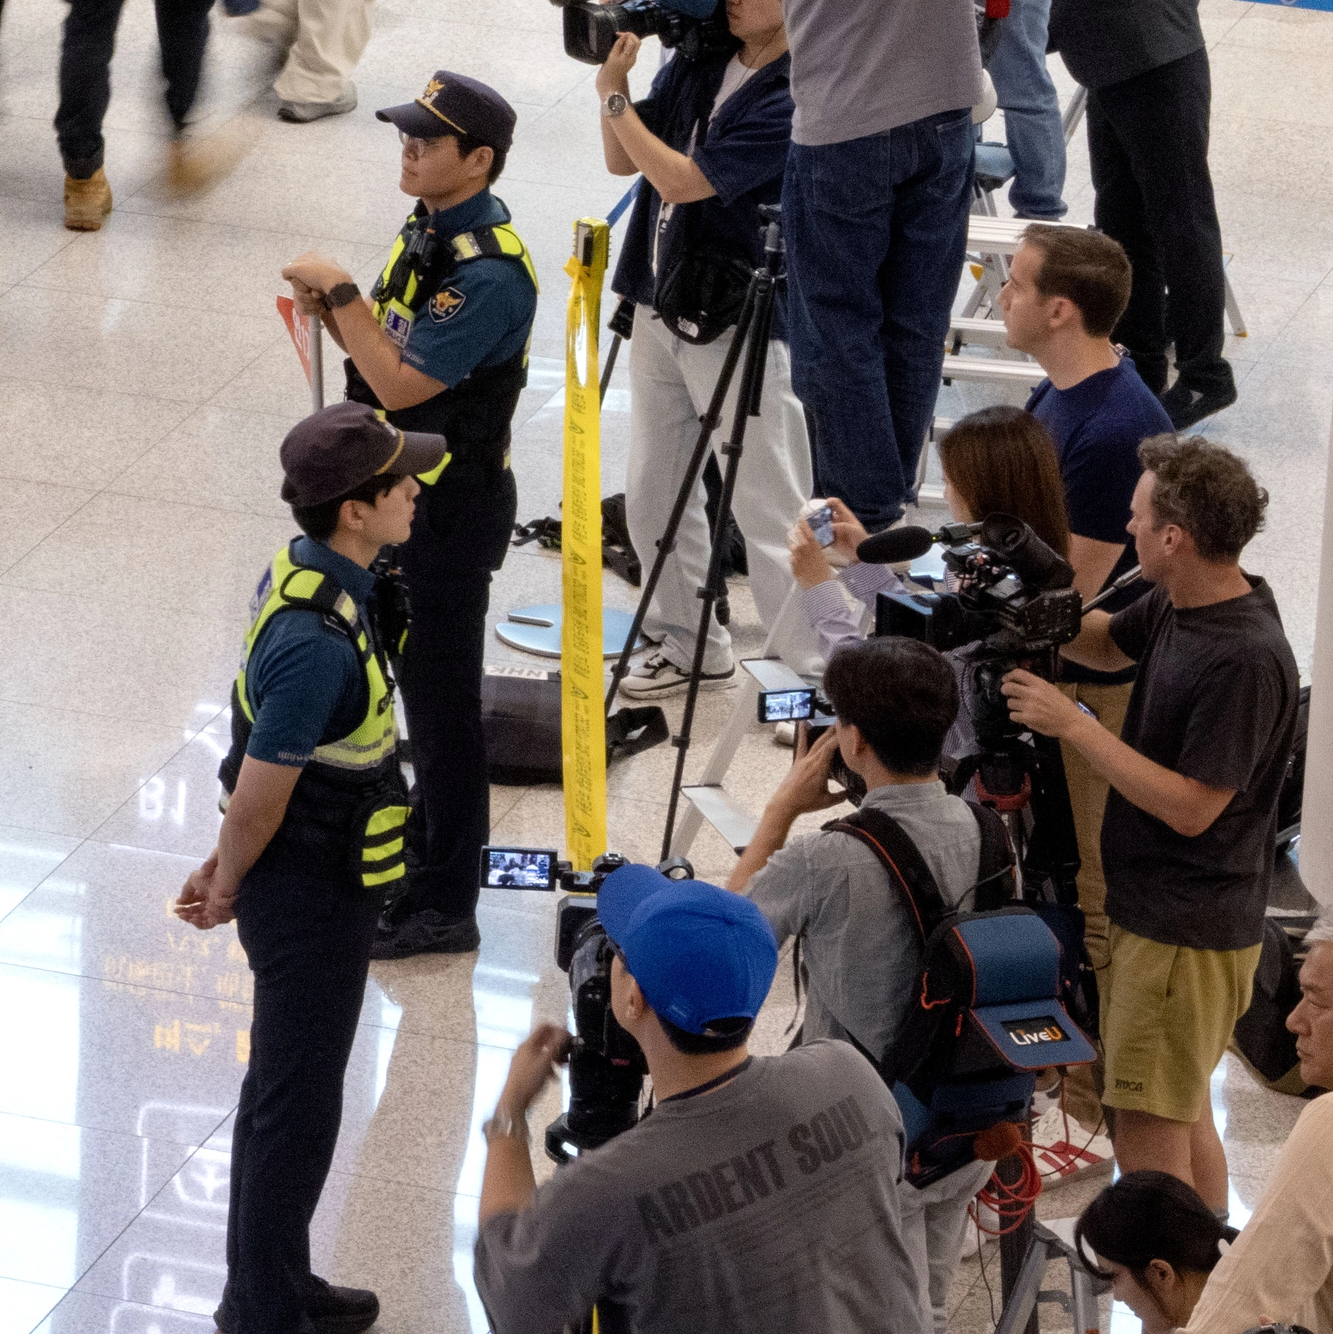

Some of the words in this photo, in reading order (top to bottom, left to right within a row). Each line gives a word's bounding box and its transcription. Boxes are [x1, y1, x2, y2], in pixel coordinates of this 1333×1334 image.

[1009, 1026, 1063, 1046] LiveU
[635, 1138, 786, 1244] ARDENT
[787, 1095, 879, 1176] SOUL
